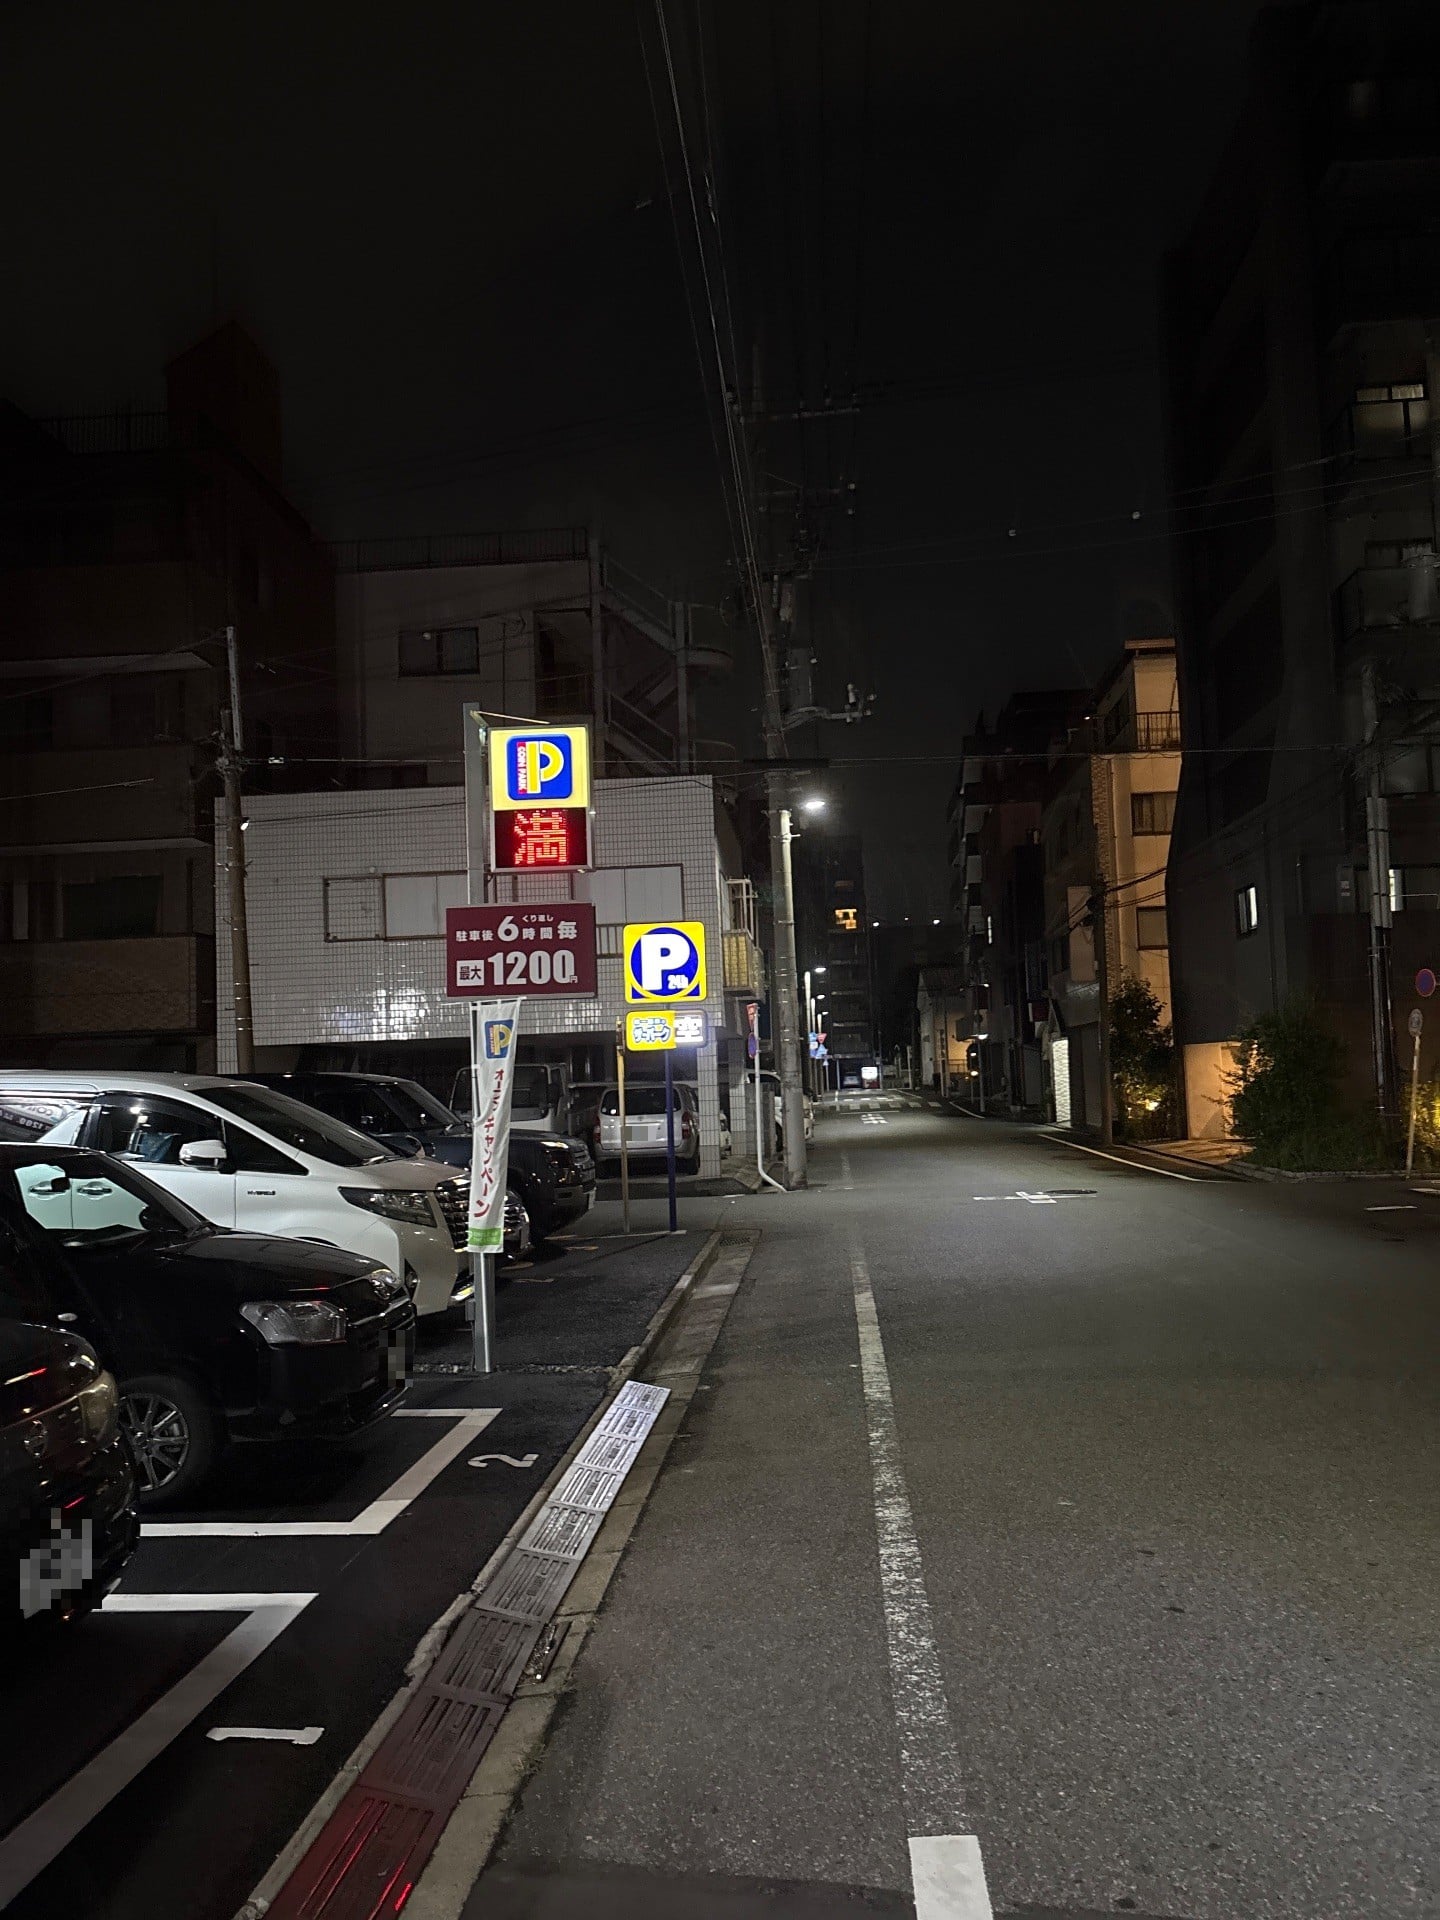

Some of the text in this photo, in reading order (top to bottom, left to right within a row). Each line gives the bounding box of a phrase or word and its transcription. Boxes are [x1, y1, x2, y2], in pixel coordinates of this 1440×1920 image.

[526, 741, 565, 794] P
[514, 811, 567, 865] 満
[455, 915, 578, 942] 駐車後6時間毎
[522, 914, 554, 922] くり返し
[459, 965, 482, 980] 最大
[640, 933, 691, 991] P
[673, 1015, 704, 1042] 空
[467, 1453, 540, 1468] 2
[205, 1726, 325, 1745] 1
